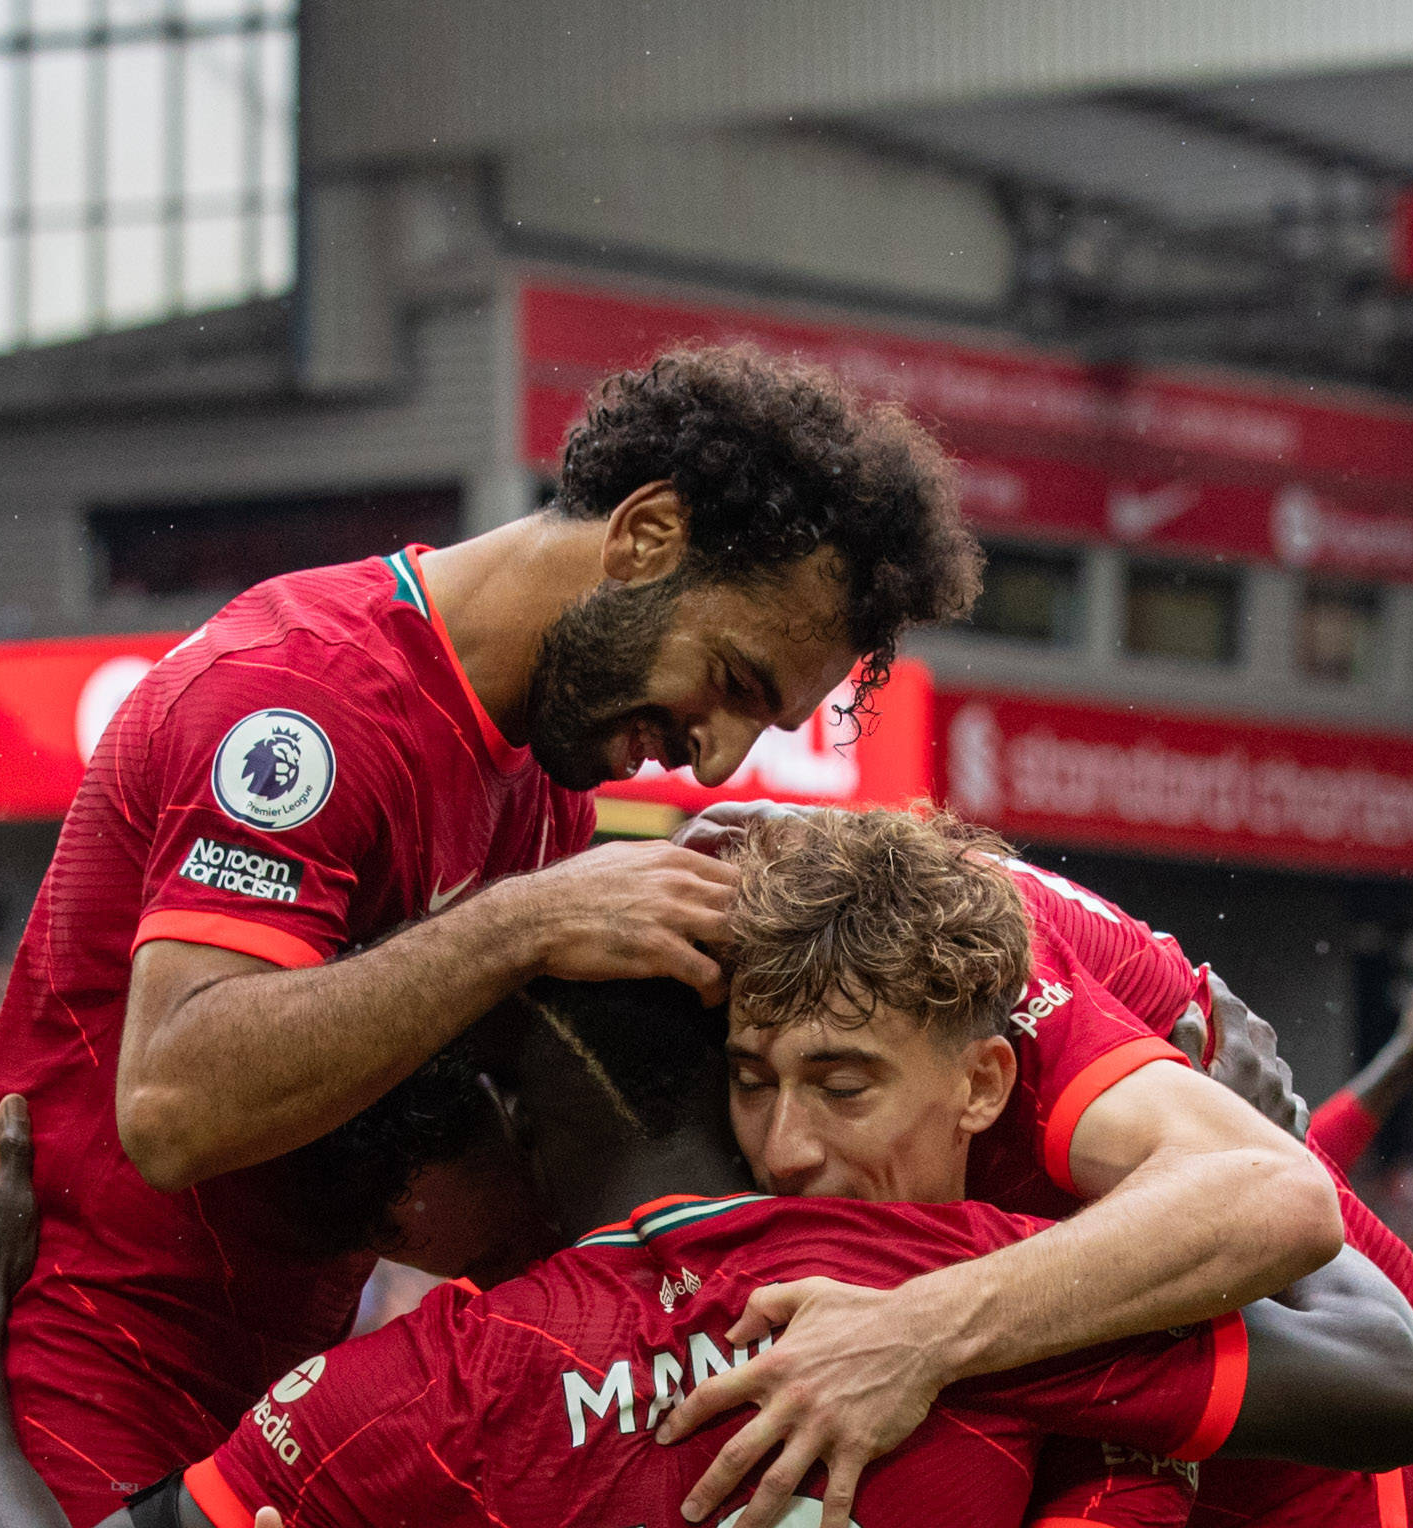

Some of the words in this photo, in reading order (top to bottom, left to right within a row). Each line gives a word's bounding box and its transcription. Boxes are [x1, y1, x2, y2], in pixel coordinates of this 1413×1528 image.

[246, 800, 281, 817] Premier
[283, 784, 313, 815] League
[188, 837, 224, 866] No
[224, 849, 290, 883] room
[216, 869, 297, 904] racism
[561, 1325, 774, 1448] MAN
